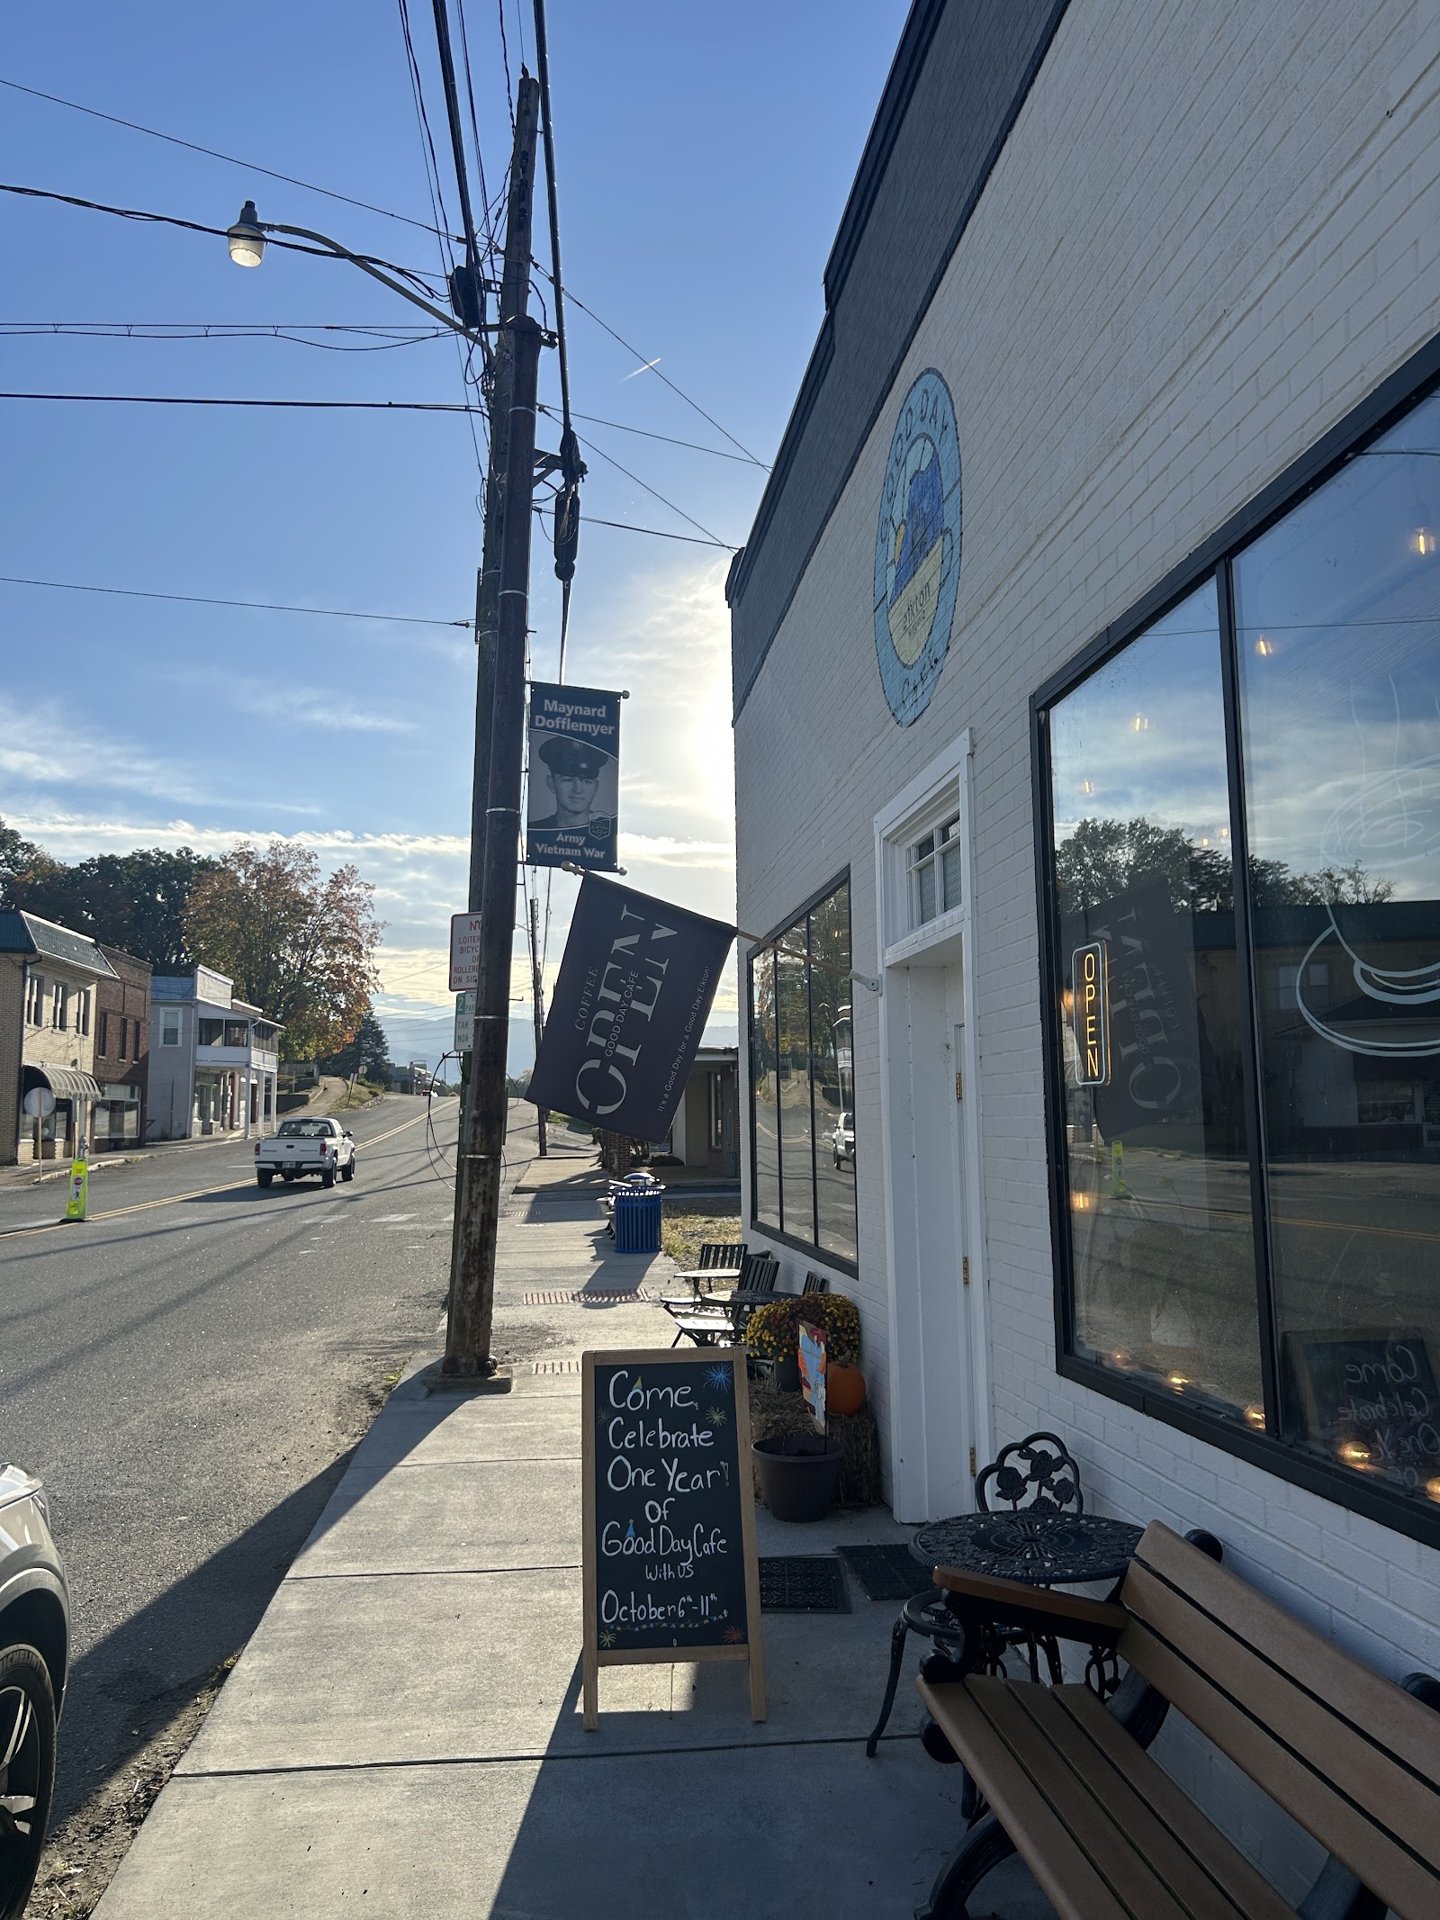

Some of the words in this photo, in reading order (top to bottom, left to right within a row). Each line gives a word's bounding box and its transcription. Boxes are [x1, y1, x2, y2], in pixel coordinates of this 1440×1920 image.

[880, 406, 913, 545] GOOD
[919, 388, 949, 447] DAY
[534, 715, 616, 737] Dofflemyer
[543, 699, 606, 718] Maynard
[535, 843, 582, 857] Vietnam
[583, 847, 606, 859] War
[556, 832, 587, 847] Army
[453, 976, 463, 984] ON
[457, 996, 464, 1011] 2
[574, 965, 599, 1031] COFFEE
[575, 903, 678, 1115] OPEN
[1084, 953, 1098, 1077] OPEN
[604, 1024, 622, 1058] GOOD
[615, 999, 630, 1024] DAY
[664, 1070, 678, 1092] Good
[671, 1053, 685, 1072] Day
[678, 1038, 689, 1052] for
[685, 1011, 697, 1032] Good
[692, 994, 704, 1011] Day
[608, 1416, 714, 1449] Celebrate
[607, 1455, 656, 1491] One
[602, 1521, 656, 1556] Good
[660, 1525, 693, 1566] Day
[693, 1523, 728, 1558] Cafe
[601, 1589, 676, 1623] October
